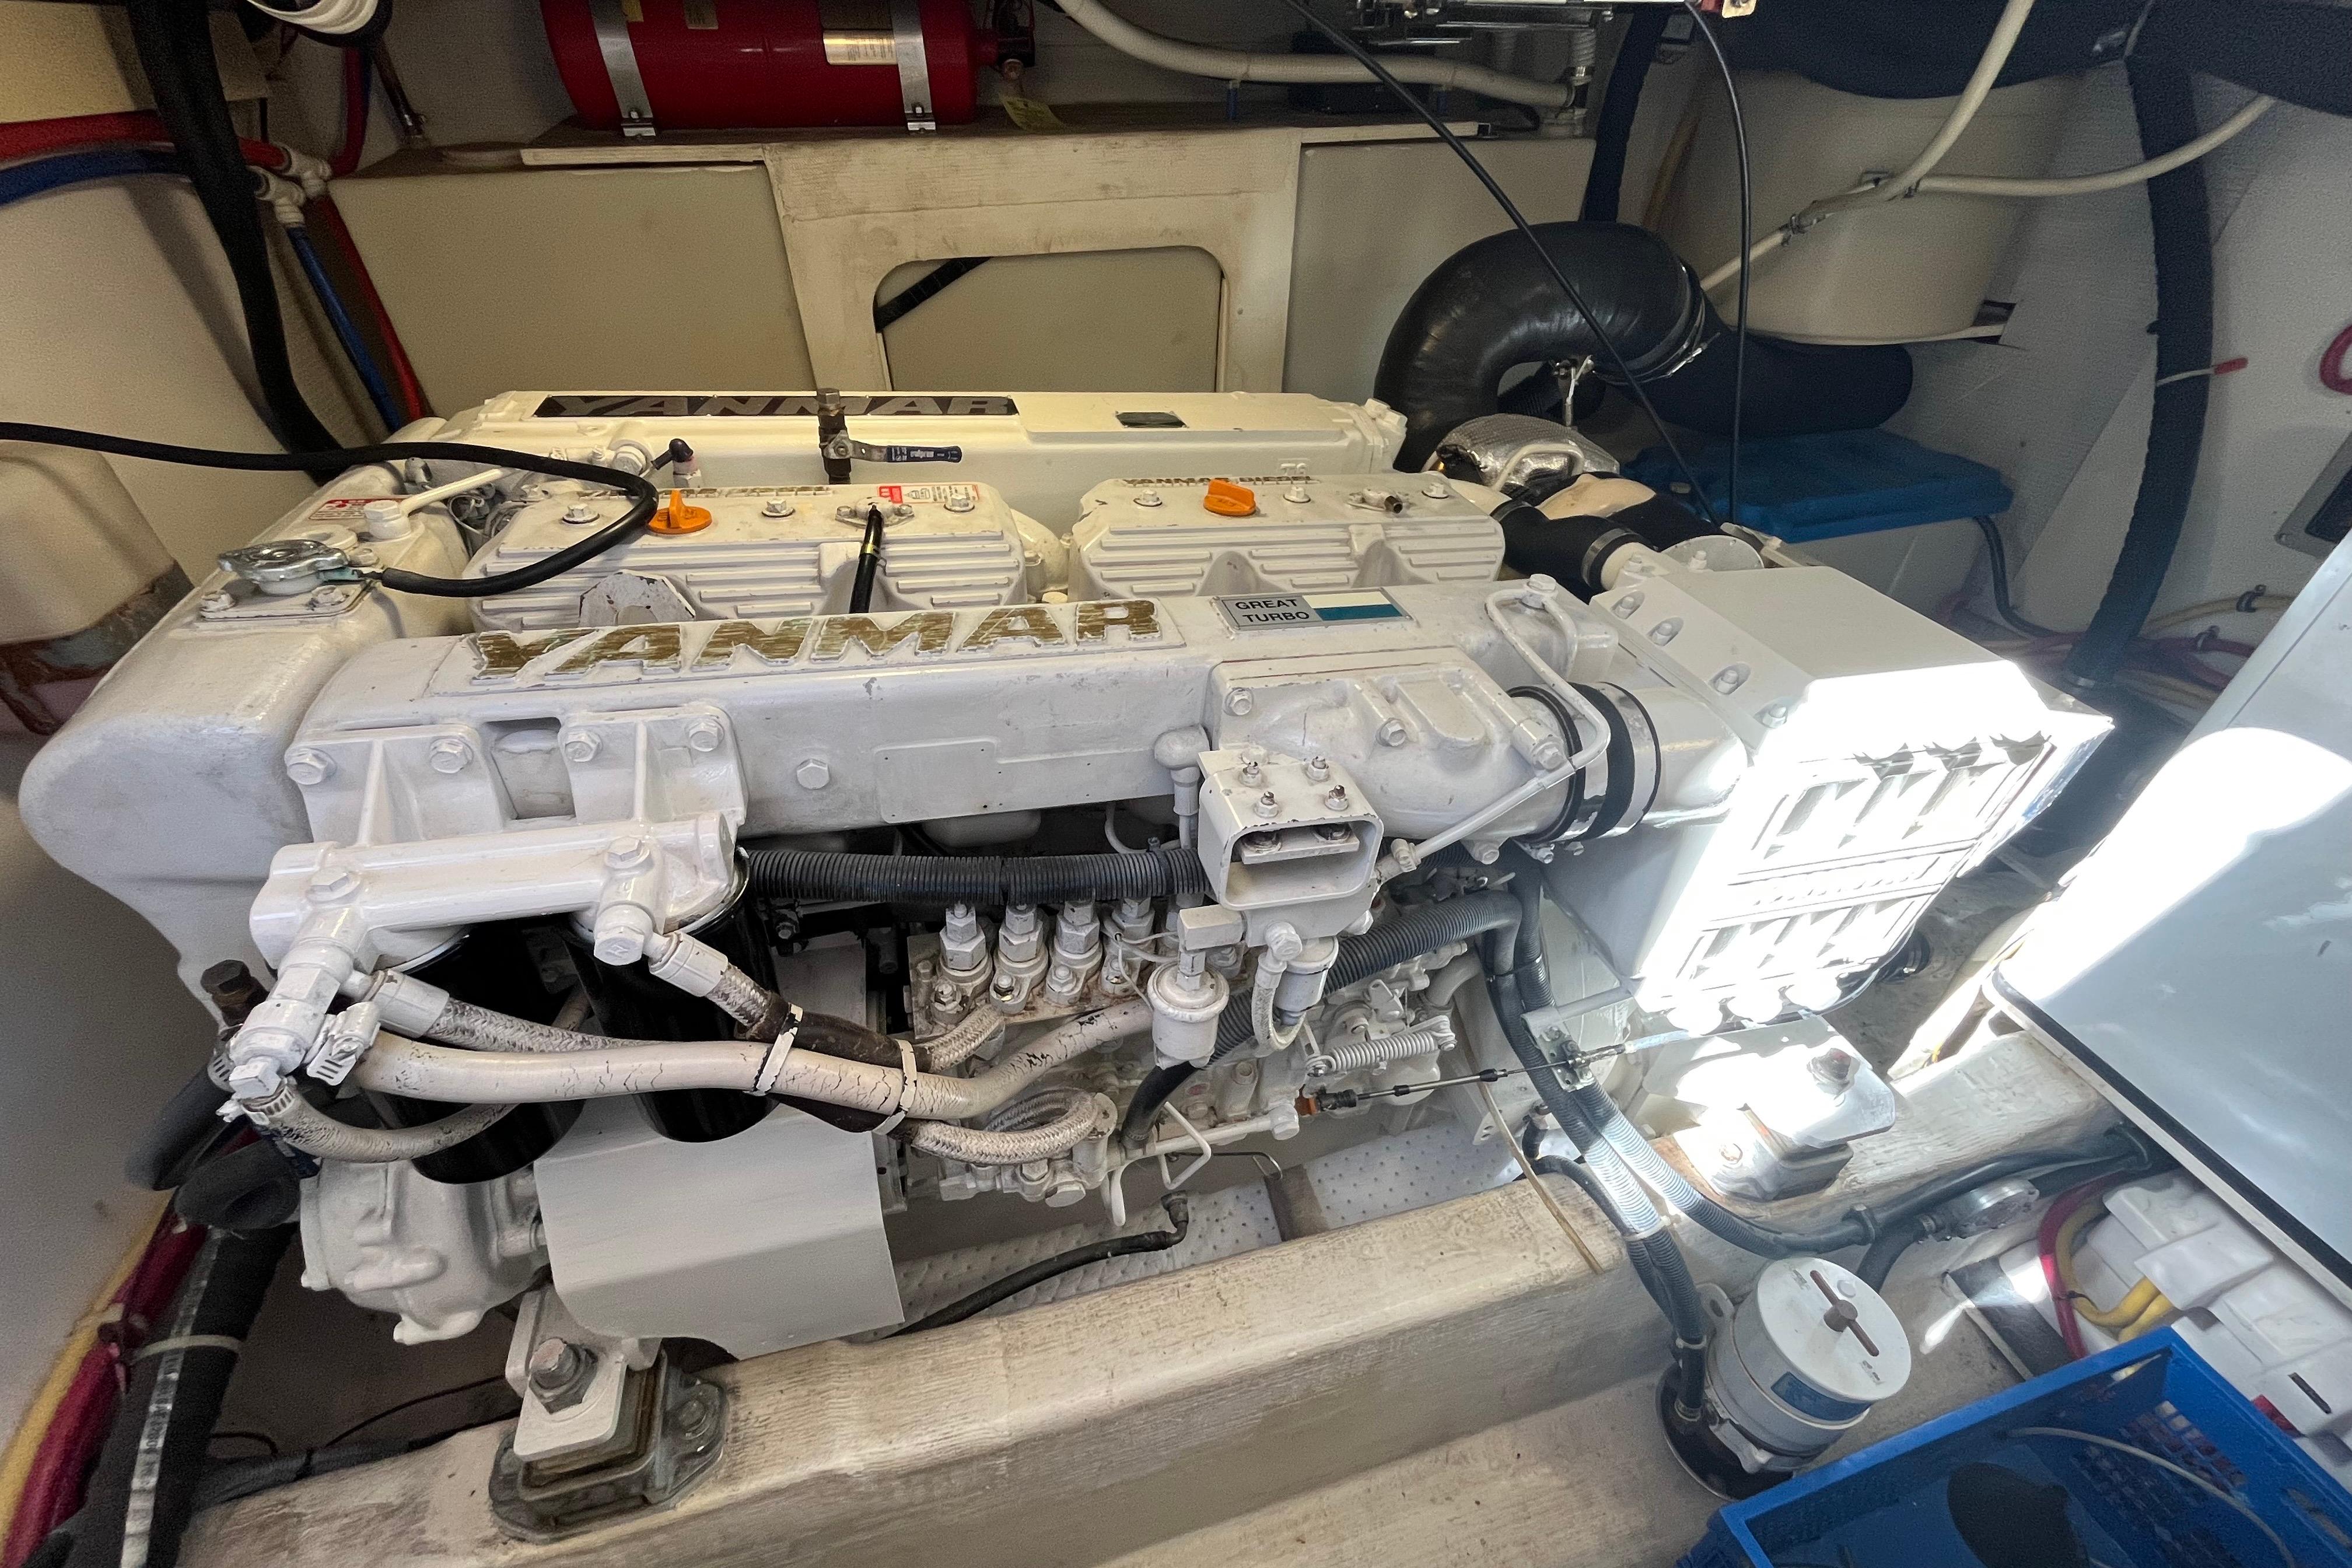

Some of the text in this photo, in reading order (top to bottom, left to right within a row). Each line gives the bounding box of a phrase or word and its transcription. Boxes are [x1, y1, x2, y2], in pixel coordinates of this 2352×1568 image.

[553, 396, 1009, 416] YANMAR
[1235, 598, 1298, 610] GREAT
[1242, 611, 1310, 623] TURBO
[473, 600, 1162, 684] YANMAR
